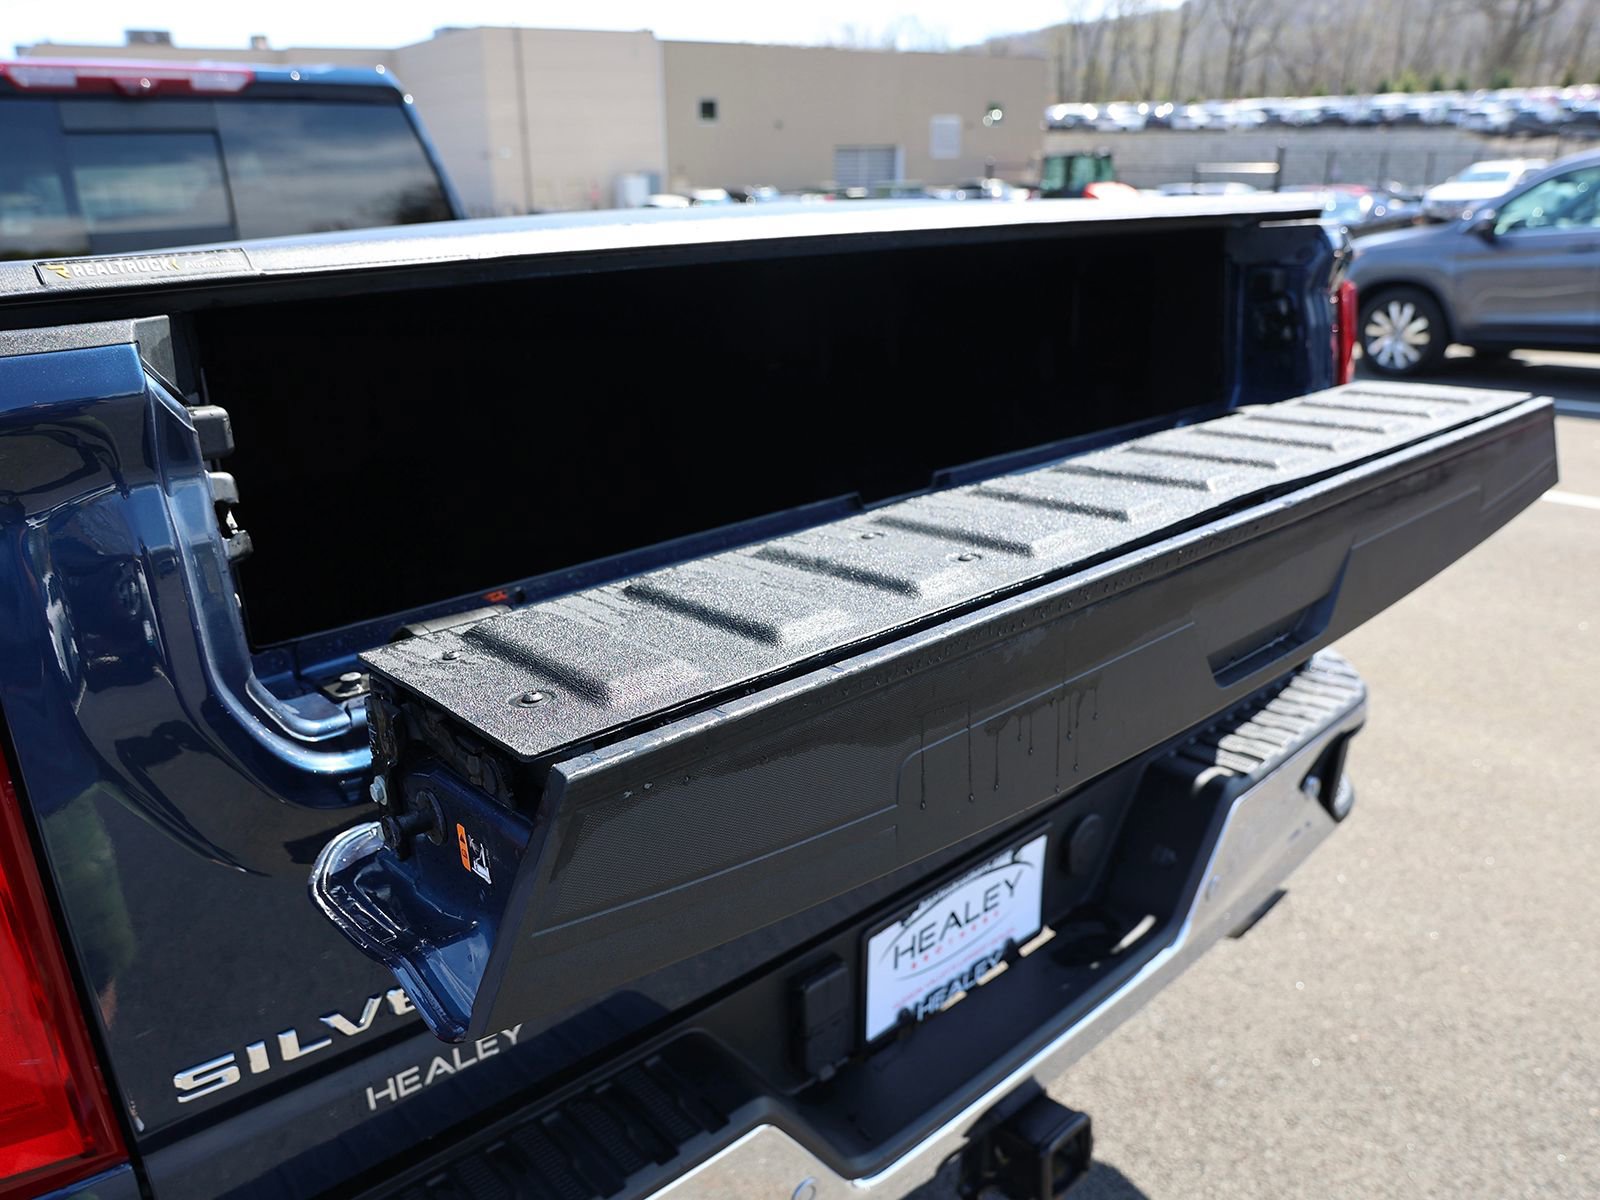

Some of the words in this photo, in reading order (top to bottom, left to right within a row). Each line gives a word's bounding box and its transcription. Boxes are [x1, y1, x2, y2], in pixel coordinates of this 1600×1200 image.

[73, 257, 179, 278] REALTRUCK
[893, 869, 1023, 970] HEALEY
[914, 949, 1003, 1021] HEALEY
[366, 1023, 523, 1111] HEALEY
